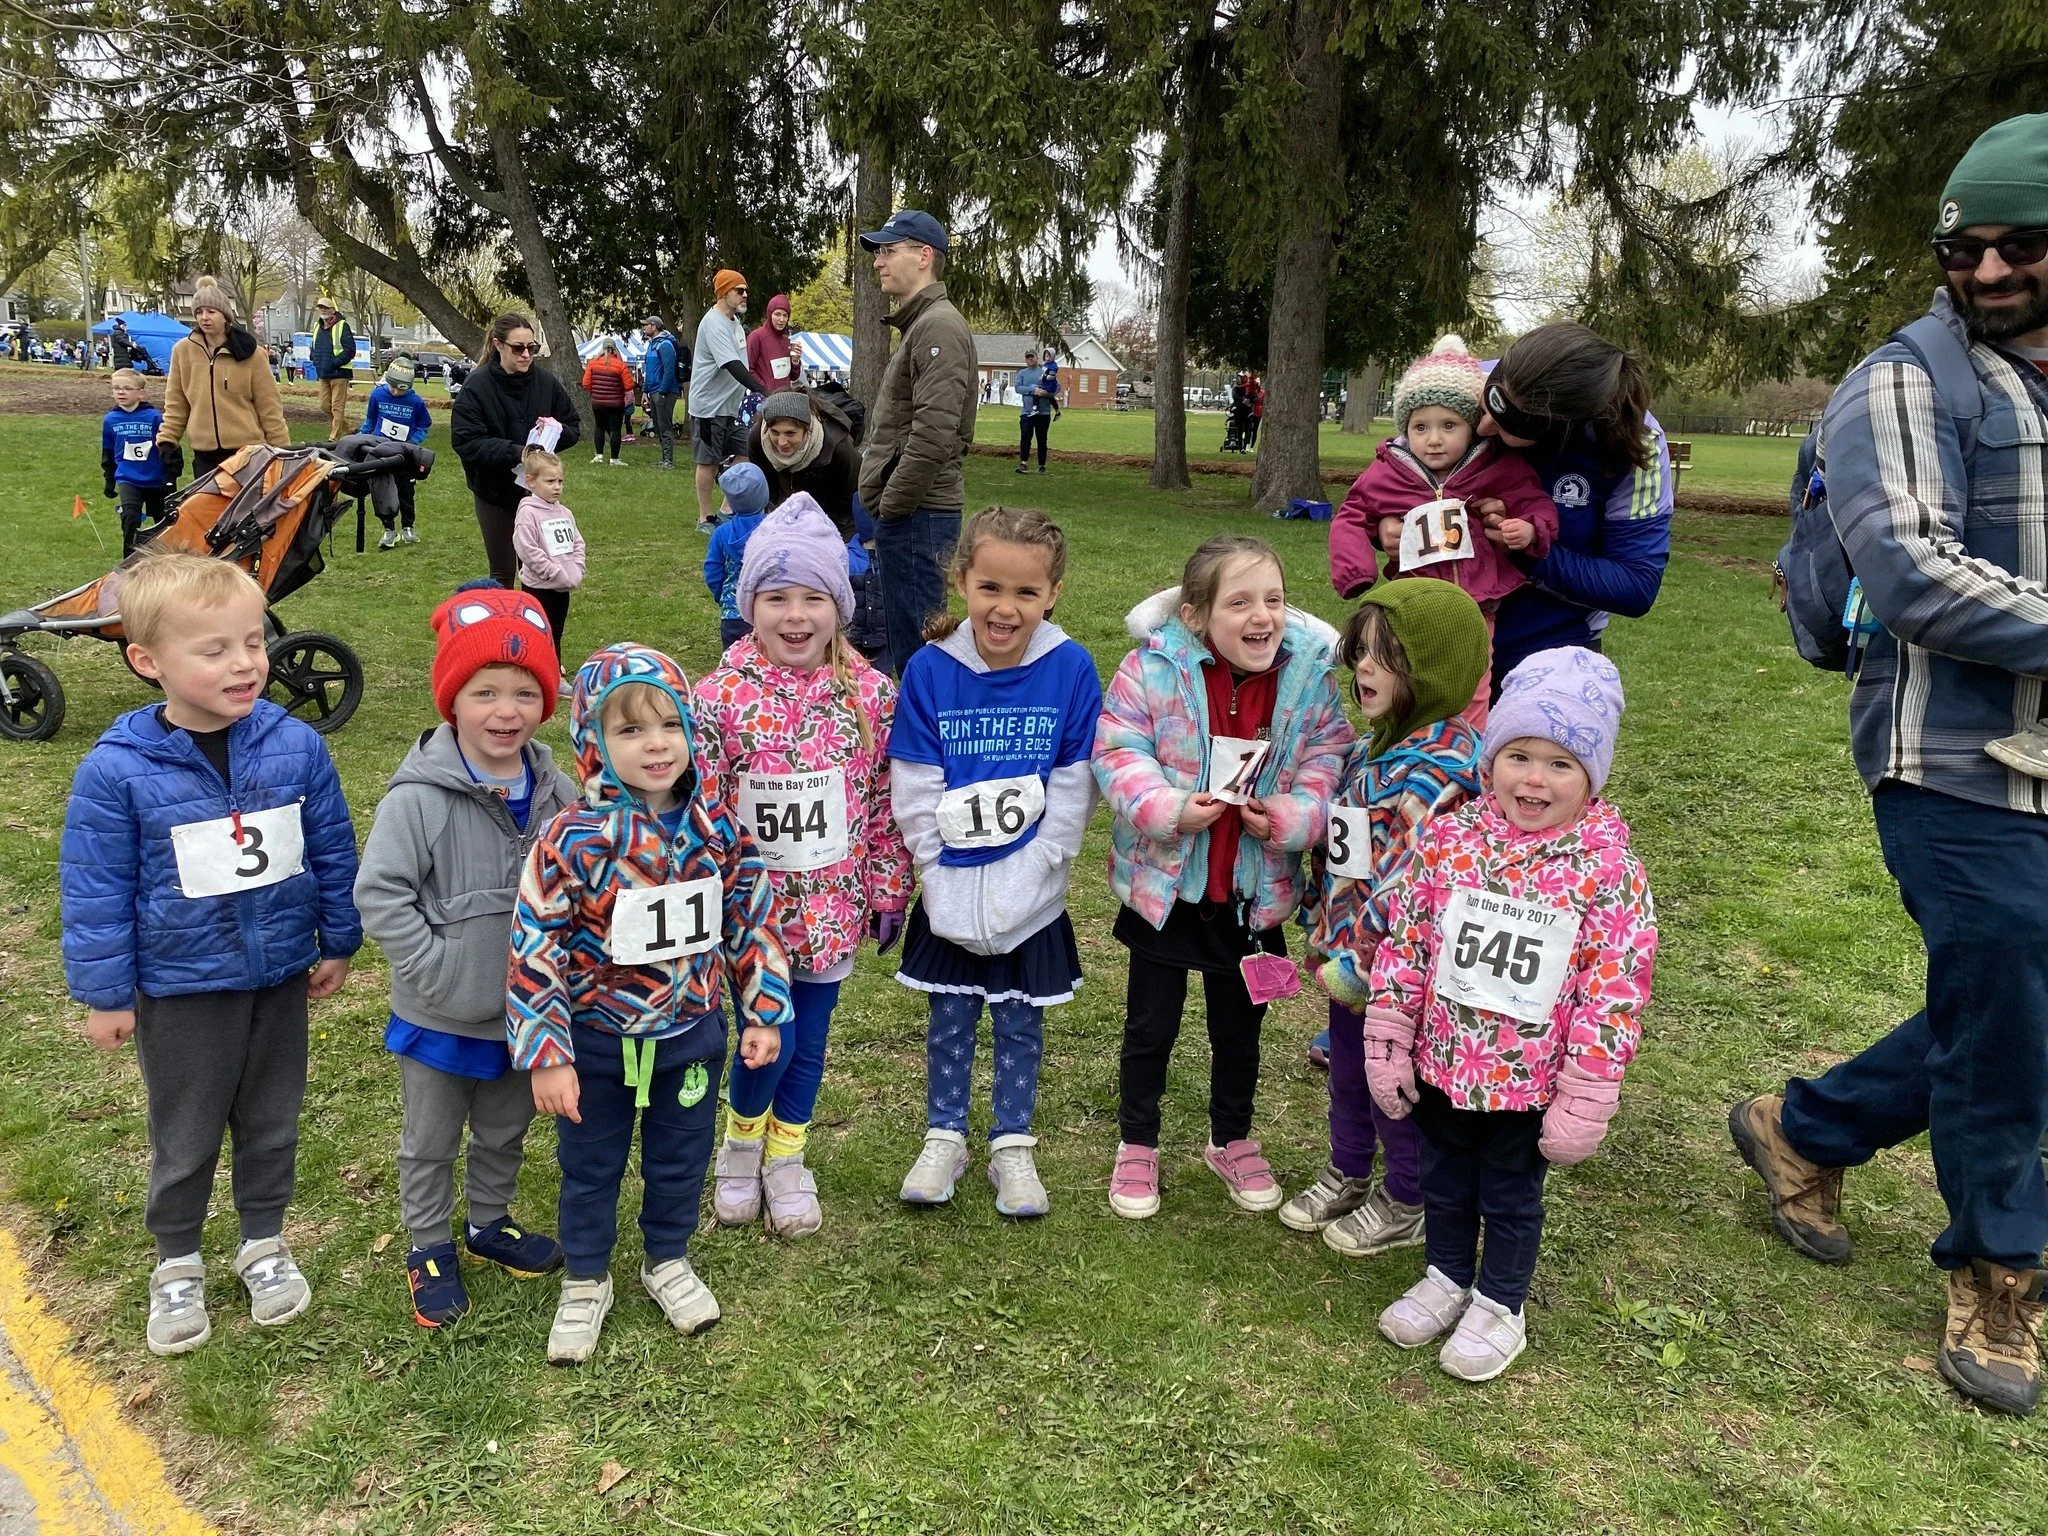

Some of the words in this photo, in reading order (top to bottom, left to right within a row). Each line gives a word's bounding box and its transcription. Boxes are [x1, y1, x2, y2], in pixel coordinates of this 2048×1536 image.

[390, 425, 399, 436] 5
[134, 446, 144, 458] 6
[1415, 509, 1463, 557] 15
[975, 707, 996, 715] PUBLIC
[984, 739, 1012, 752] MAY
[1014, 738, 1022, 751] 3
[1025, 737, 1052, 751] 2025
[750, 779, 766, 790] Run
[768, 780, 783, 791] the
[786, 780, 804, 791] Bay
[807, 775, 830, 789] 2017
[755, 799, 828, 843] 544
[963, 788, 1026, 838] 16
[229, 826, 270, 878] 3
[645, 892, 711, 952] 11
[1465, 893, 1479, 907] Run
[1481, 898, 1499, 913] the
[1502, 902, 1525, 921] Bay
[1527, 909, 1557, 926] 2017
[1454, 920, 1544, 986] 545
